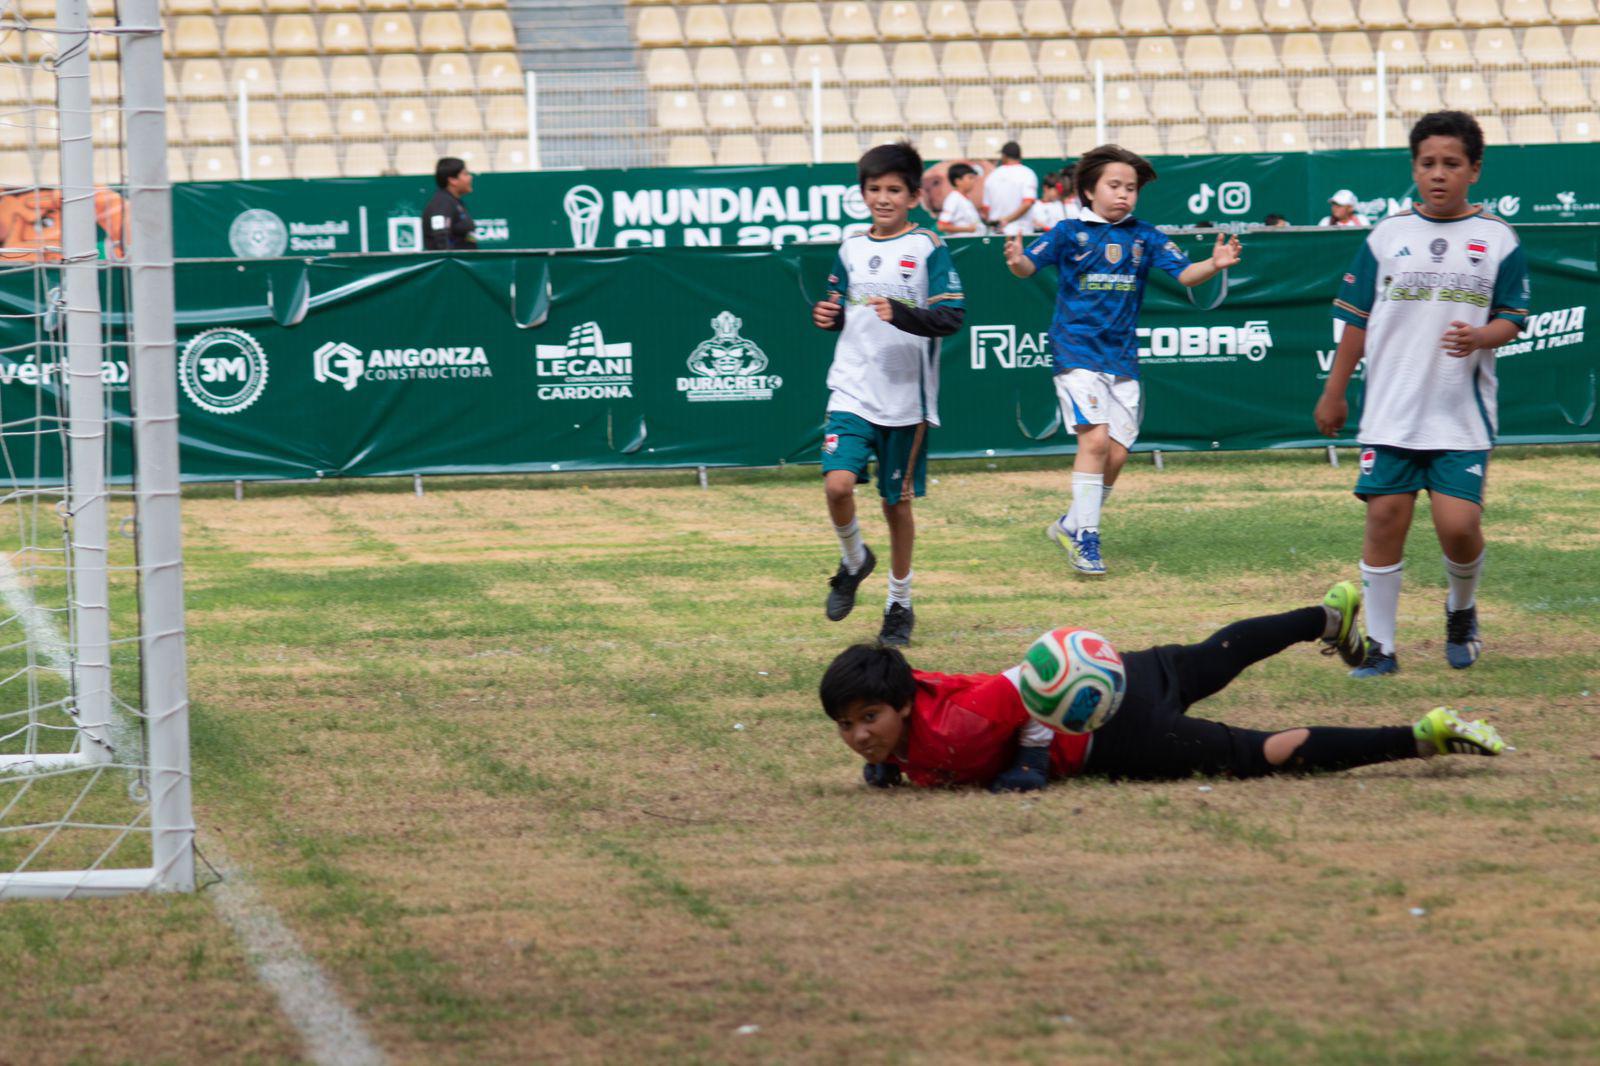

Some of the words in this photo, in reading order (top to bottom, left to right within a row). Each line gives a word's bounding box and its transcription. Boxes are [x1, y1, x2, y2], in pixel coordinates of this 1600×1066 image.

[289, 220, 349, 235] Mundial
[290, 236, 336, 251] Social
[367, 347, 489, 368] ANGONZA
[199, 356, 248, 382] 3M
[364, 366, 494, 381] CONSTRUCTORA
[536, 358, 633, 377] LECANI
[537, 386, 633, 400] CARDONA
